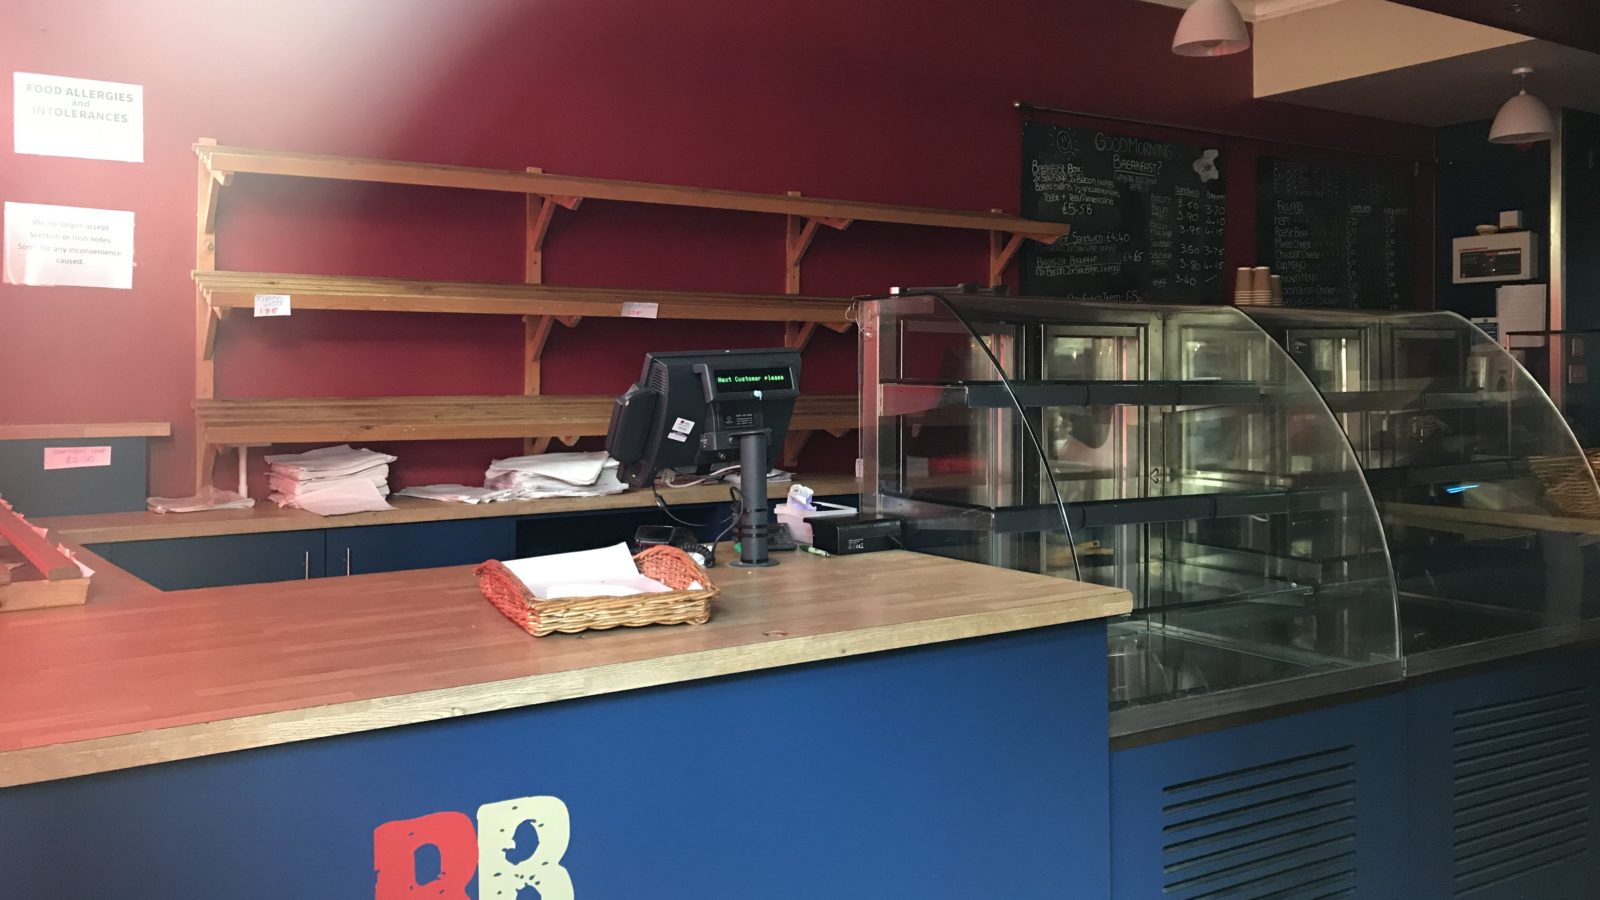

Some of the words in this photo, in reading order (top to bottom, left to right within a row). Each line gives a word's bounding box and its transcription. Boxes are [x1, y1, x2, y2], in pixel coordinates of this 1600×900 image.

[26, 83, 62, 95] FOOD
[65, 87, 134, 103] ALLERGIES
[71, 100, 90, 108] and
[33, 106, 128, 123] INTOLERANCES
[717, 376, 732, 384] Next
[734, 375, 762, 383] Customer
